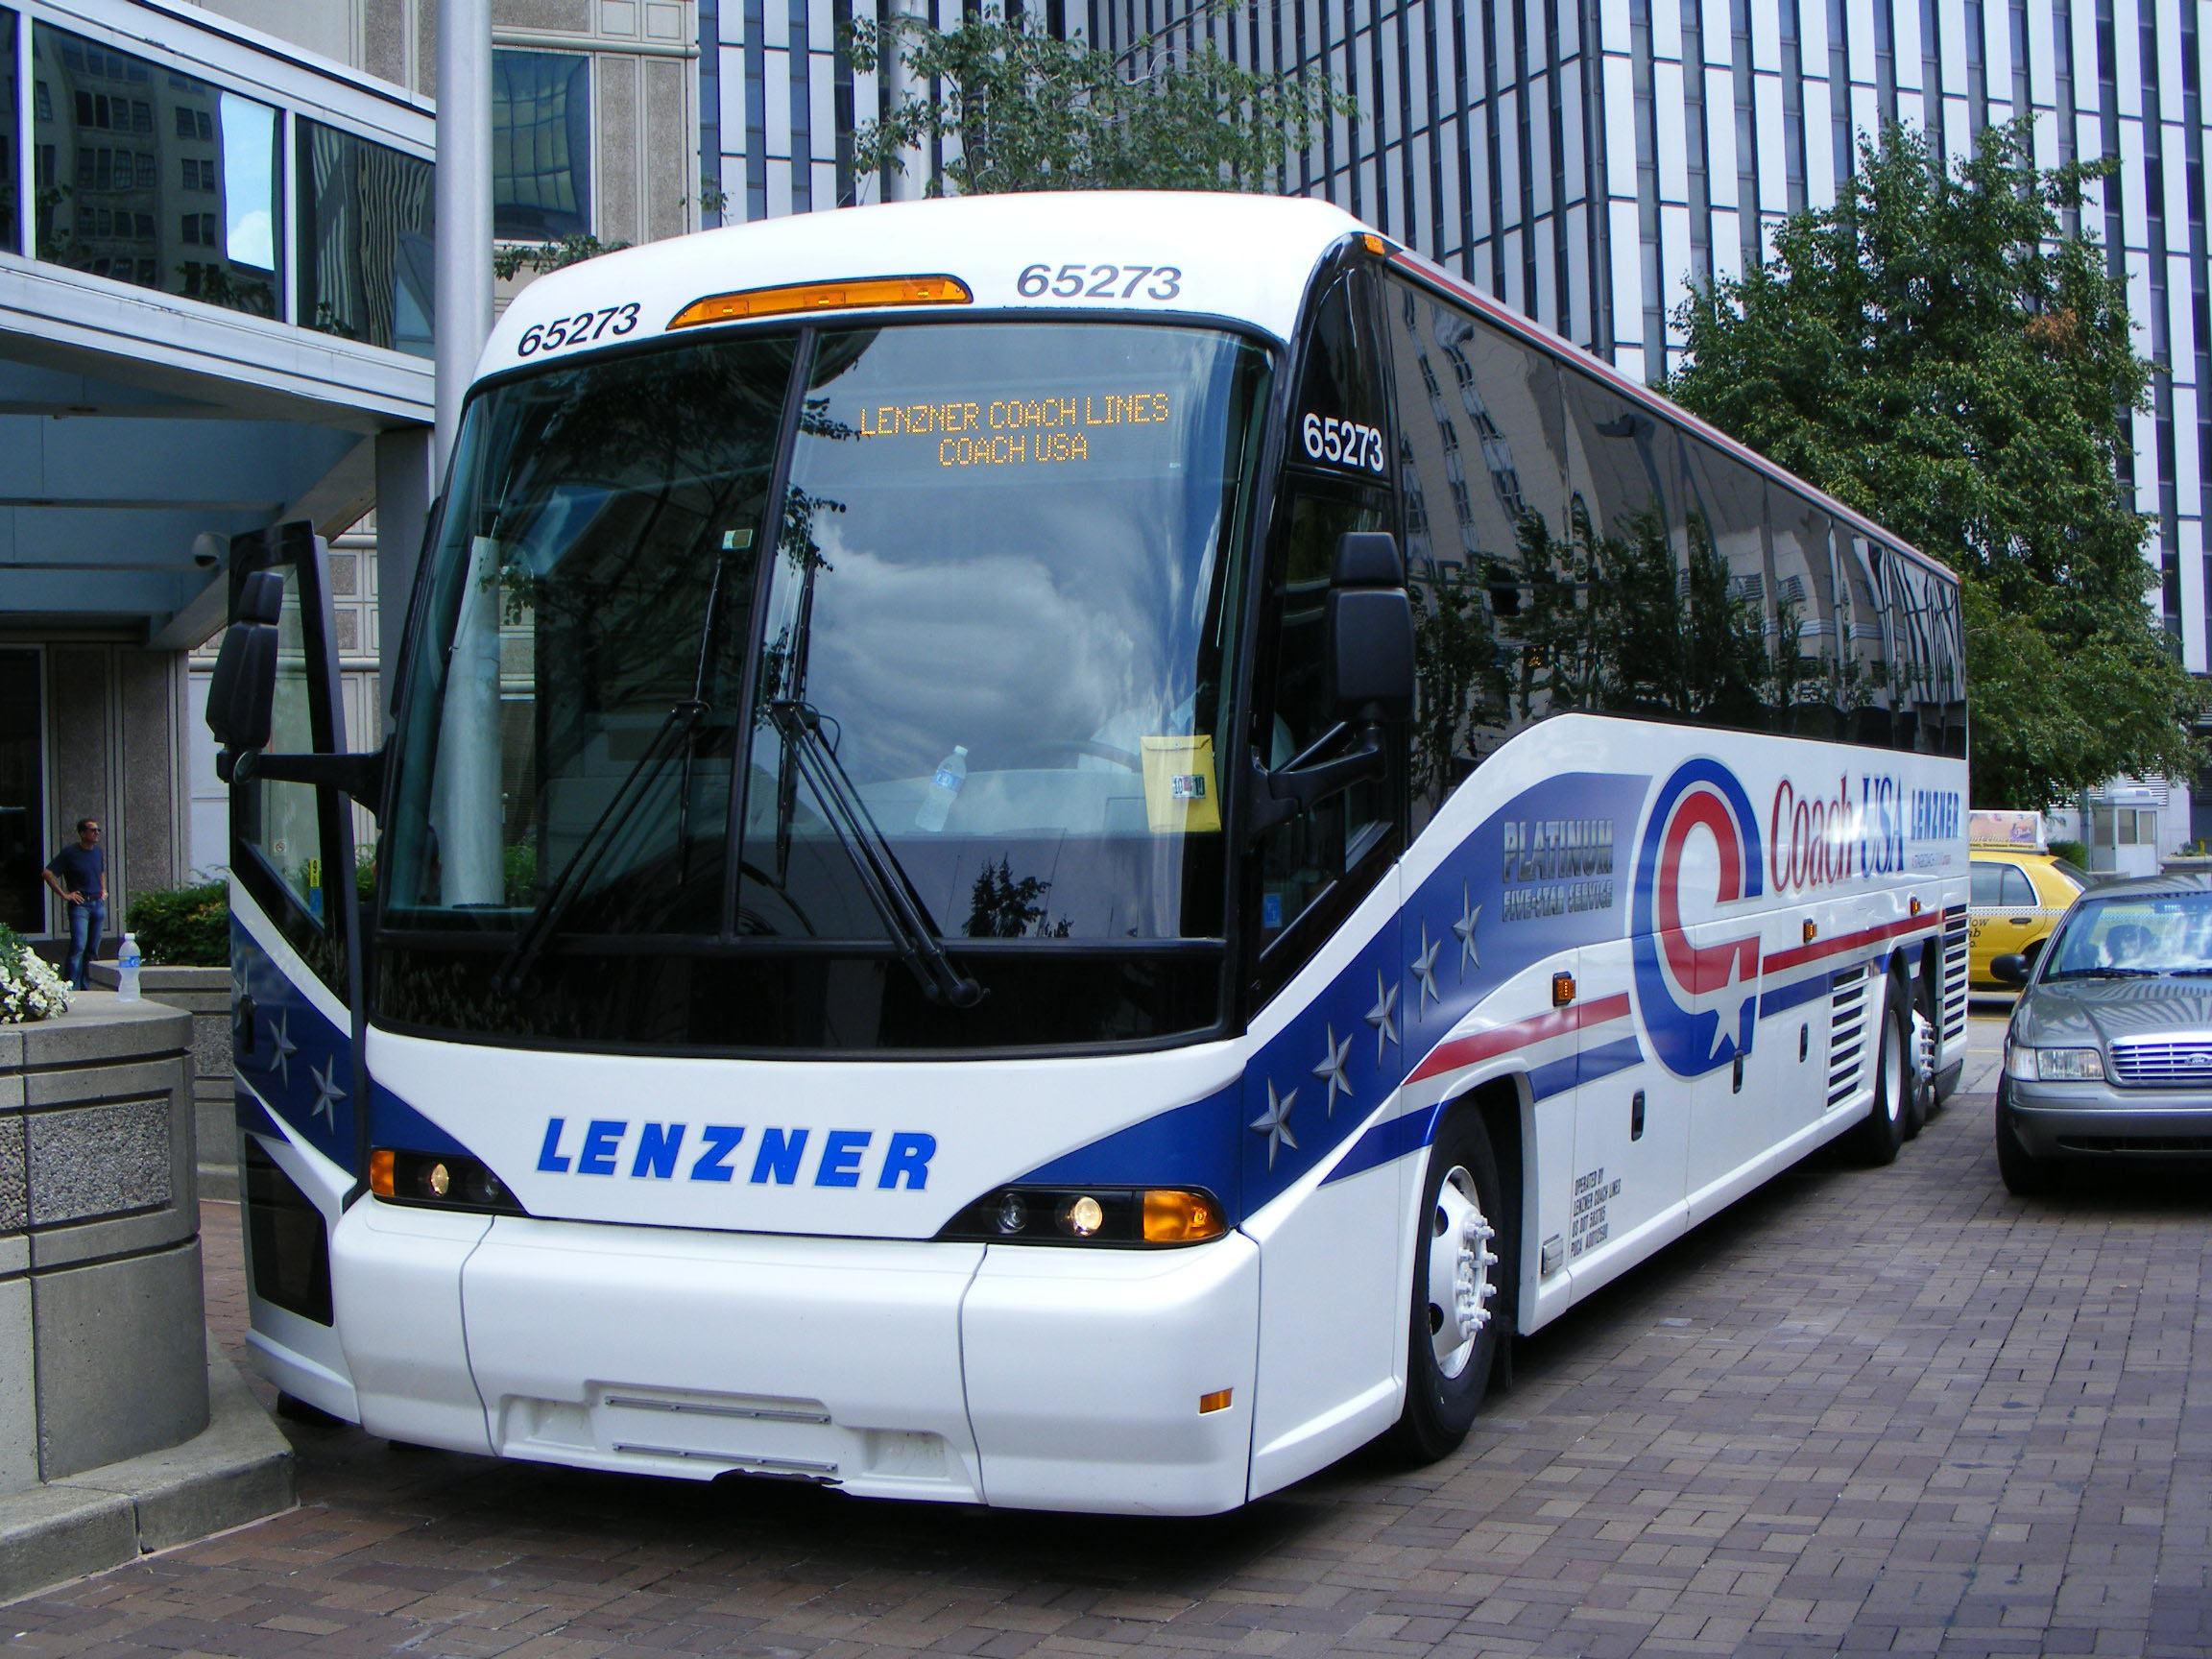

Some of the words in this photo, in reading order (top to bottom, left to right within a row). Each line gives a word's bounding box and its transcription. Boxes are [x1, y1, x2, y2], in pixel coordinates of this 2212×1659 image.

[1016, 264, 1182, 300] 65273
[517, 301, 641, 357] 65273
[860, 402, 980, 436] LENZNER
[989, 397, 1077, 429] COACH
[1086, 393, 1169, 425] LINES
[938, 435, 1026, 467] COACH
[1035, 432, 1089, 462] USA
[1303, 412, 1384, 472] 65273
[1769, 771, 1853, 893] Coach
[1861, 773, 1905, 879] USA
[1910, 788, 1960, 841] LENZNER
[1503, 820, 1613, 883] PLATINUM
[1503, 885, 1565, 922] FIVE-STAR
[1568, 879, 1613, 913] SERVICE
[536, 1116, 938, 1192] LENZNER
[1574, 1192, 1593, 1217] LENZNER
[1594, 1184, 1608, 1206] COACH
[1609, 1178, 1621, 1198] LINES
[1575, 1170, 1597, 1195] OPERATED
[1598, 1167, 1604, 1185] BY
[1573, 1219, 1578, 1238] US
[1579, 1214, 1589, 1234] DOT
